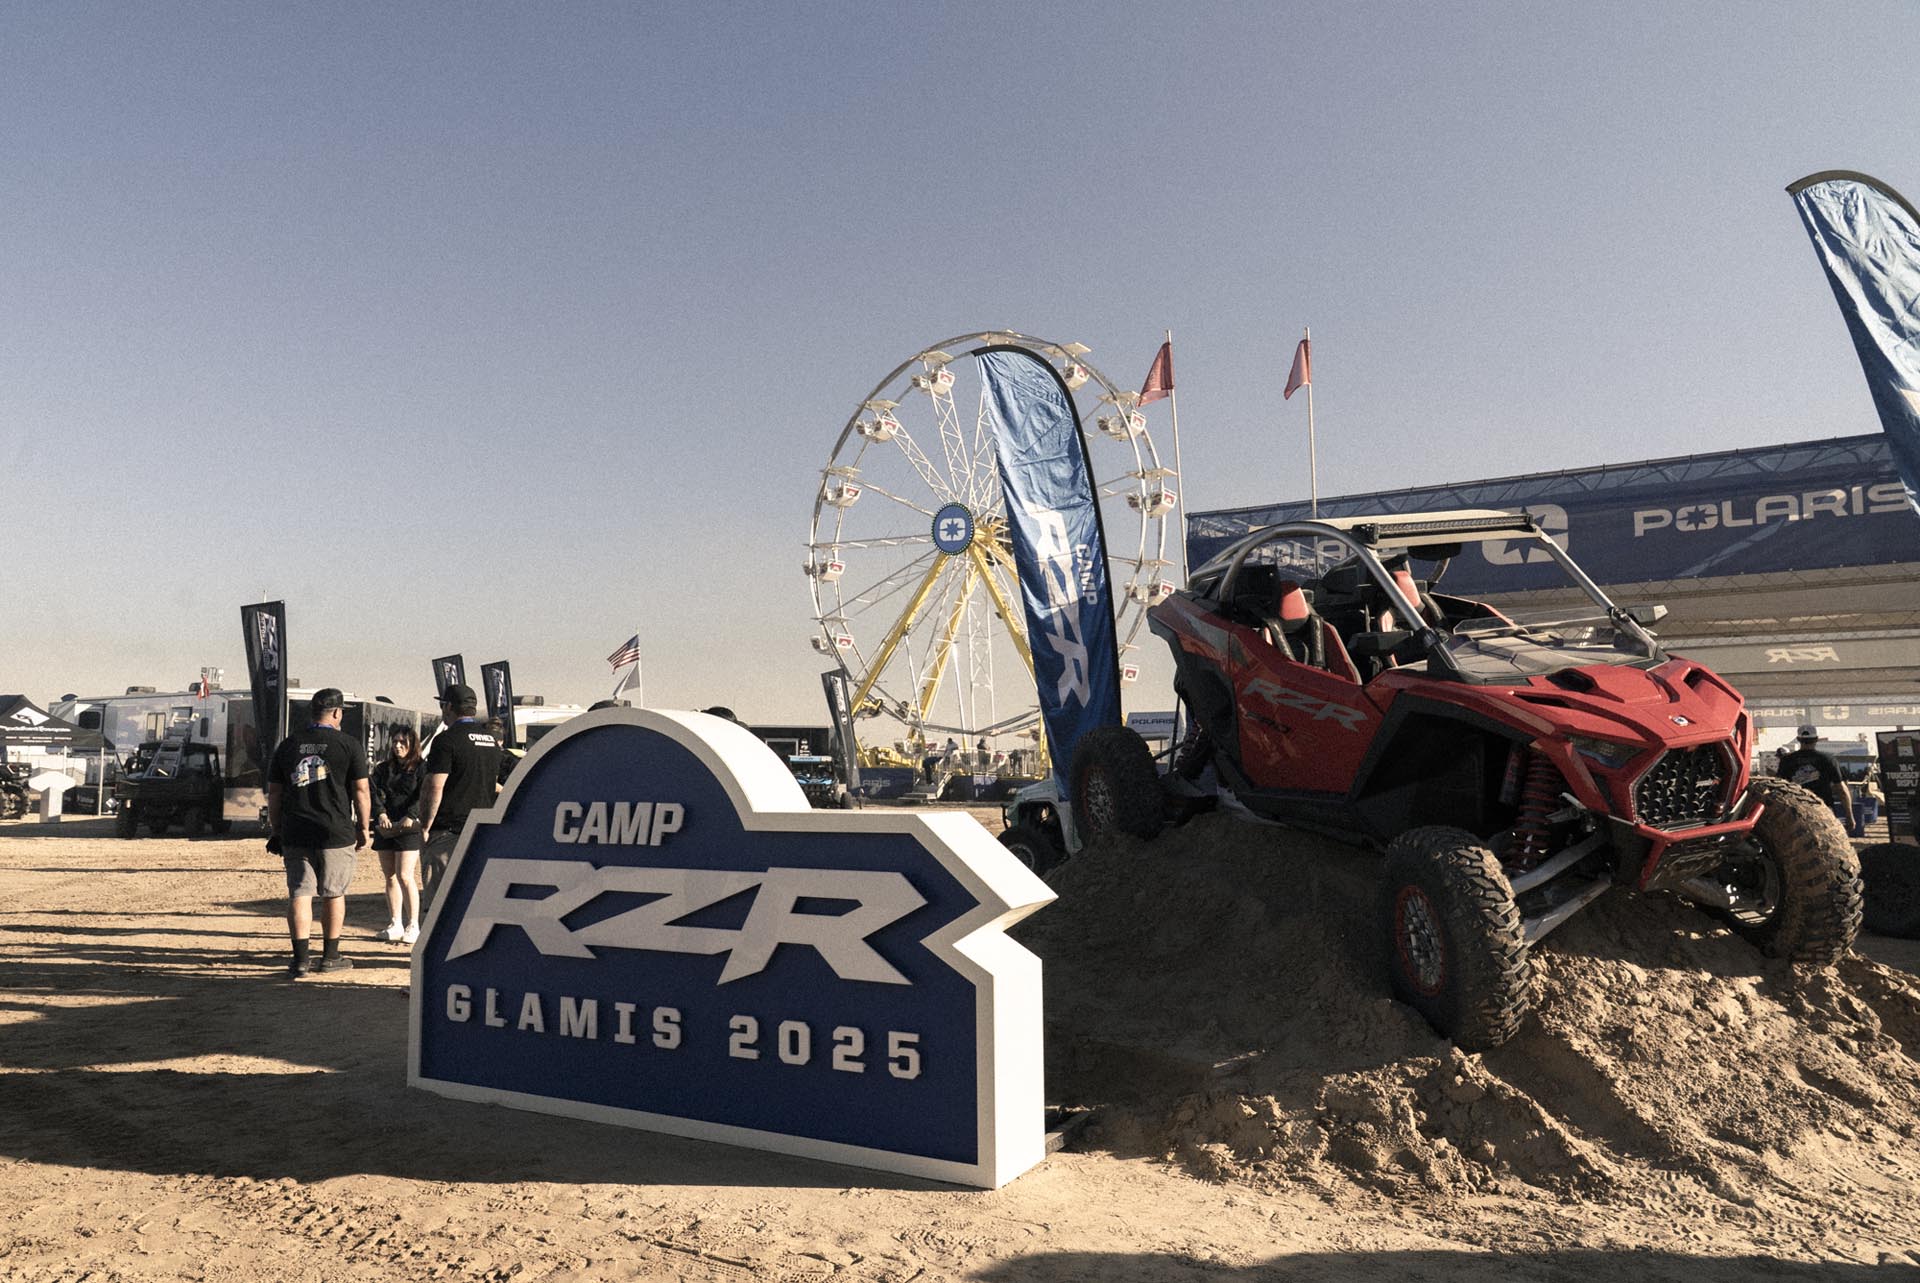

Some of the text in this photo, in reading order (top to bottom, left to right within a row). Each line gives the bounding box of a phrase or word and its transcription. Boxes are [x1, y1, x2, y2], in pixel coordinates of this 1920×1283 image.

[1634, 482, 1912, 537] POLARIS
[1021, 499, 1091, 709] RZR
[1076, 543, 1098, 605] CAMP
[1242, 677, 1368, 733] RZR
[553, 801, 685, 847] CAMP
[445, 858, 928, 985] RZR
[446, 983, 922, 1080] GLAMIS 2025
